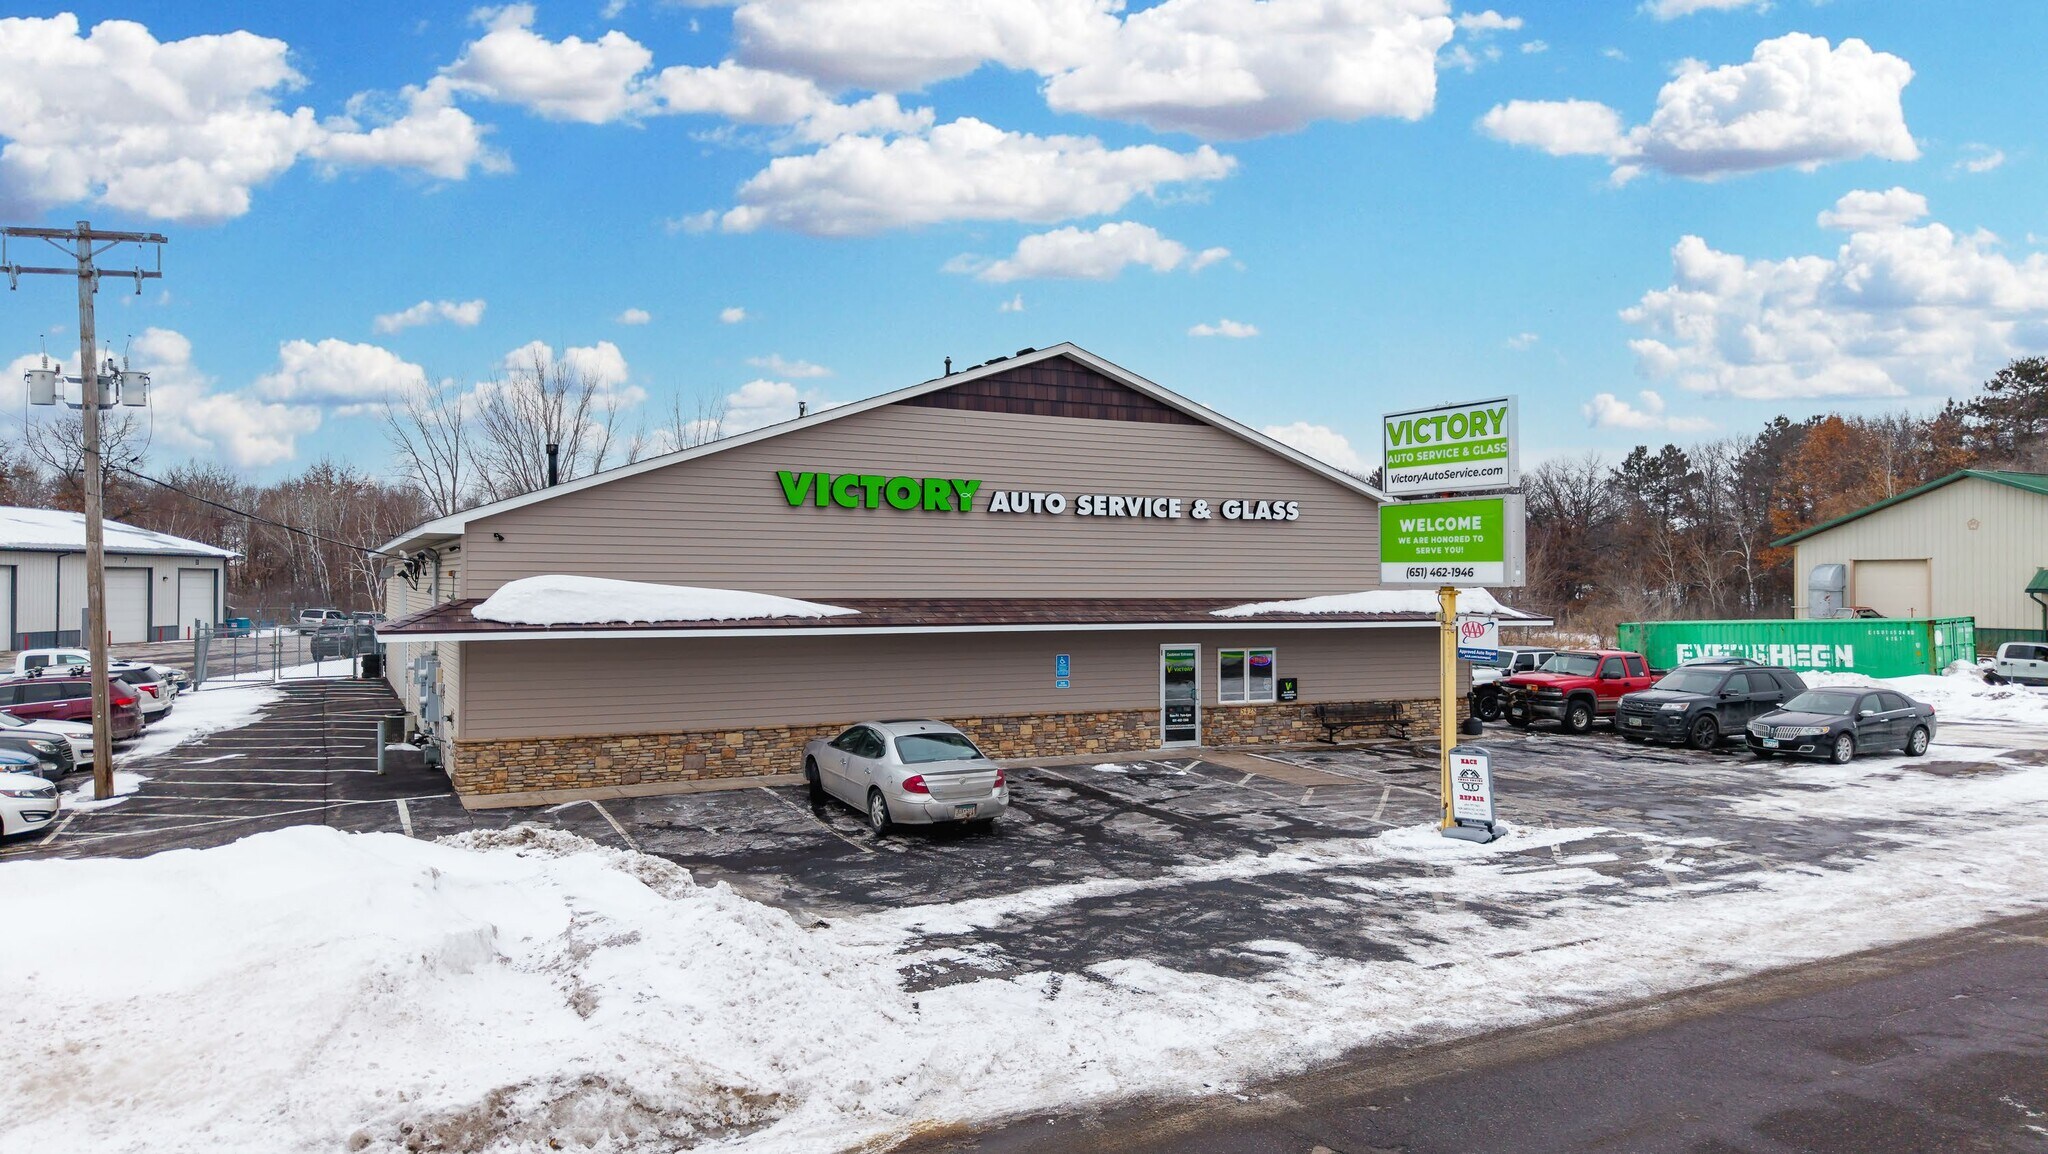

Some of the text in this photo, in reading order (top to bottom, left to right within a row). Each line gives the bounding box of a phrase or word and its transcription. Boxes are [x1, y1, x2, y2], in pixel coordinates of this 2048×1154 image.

[1387, 407, 1507, 446] VICTORY
[1388, 443, 1507, 464] AUTO SERVICE & GLASS
[1391, 467, 1503, 484] VictoryAutoService.com
[777, 471, 1300, 521] VICTORY AUTO SERVICE & GLASS
[1399, 516, 1482, 533] WELCOME
[1431, 535, 1470, 543] HONORED
[1445, 546, 1464, 554] YOU!
[1406, 567, 1474, 579] (651) 462-1946
[1463, 621, 1483, 638] AAA
[1459, 794, 1485, 802] REPAIR
